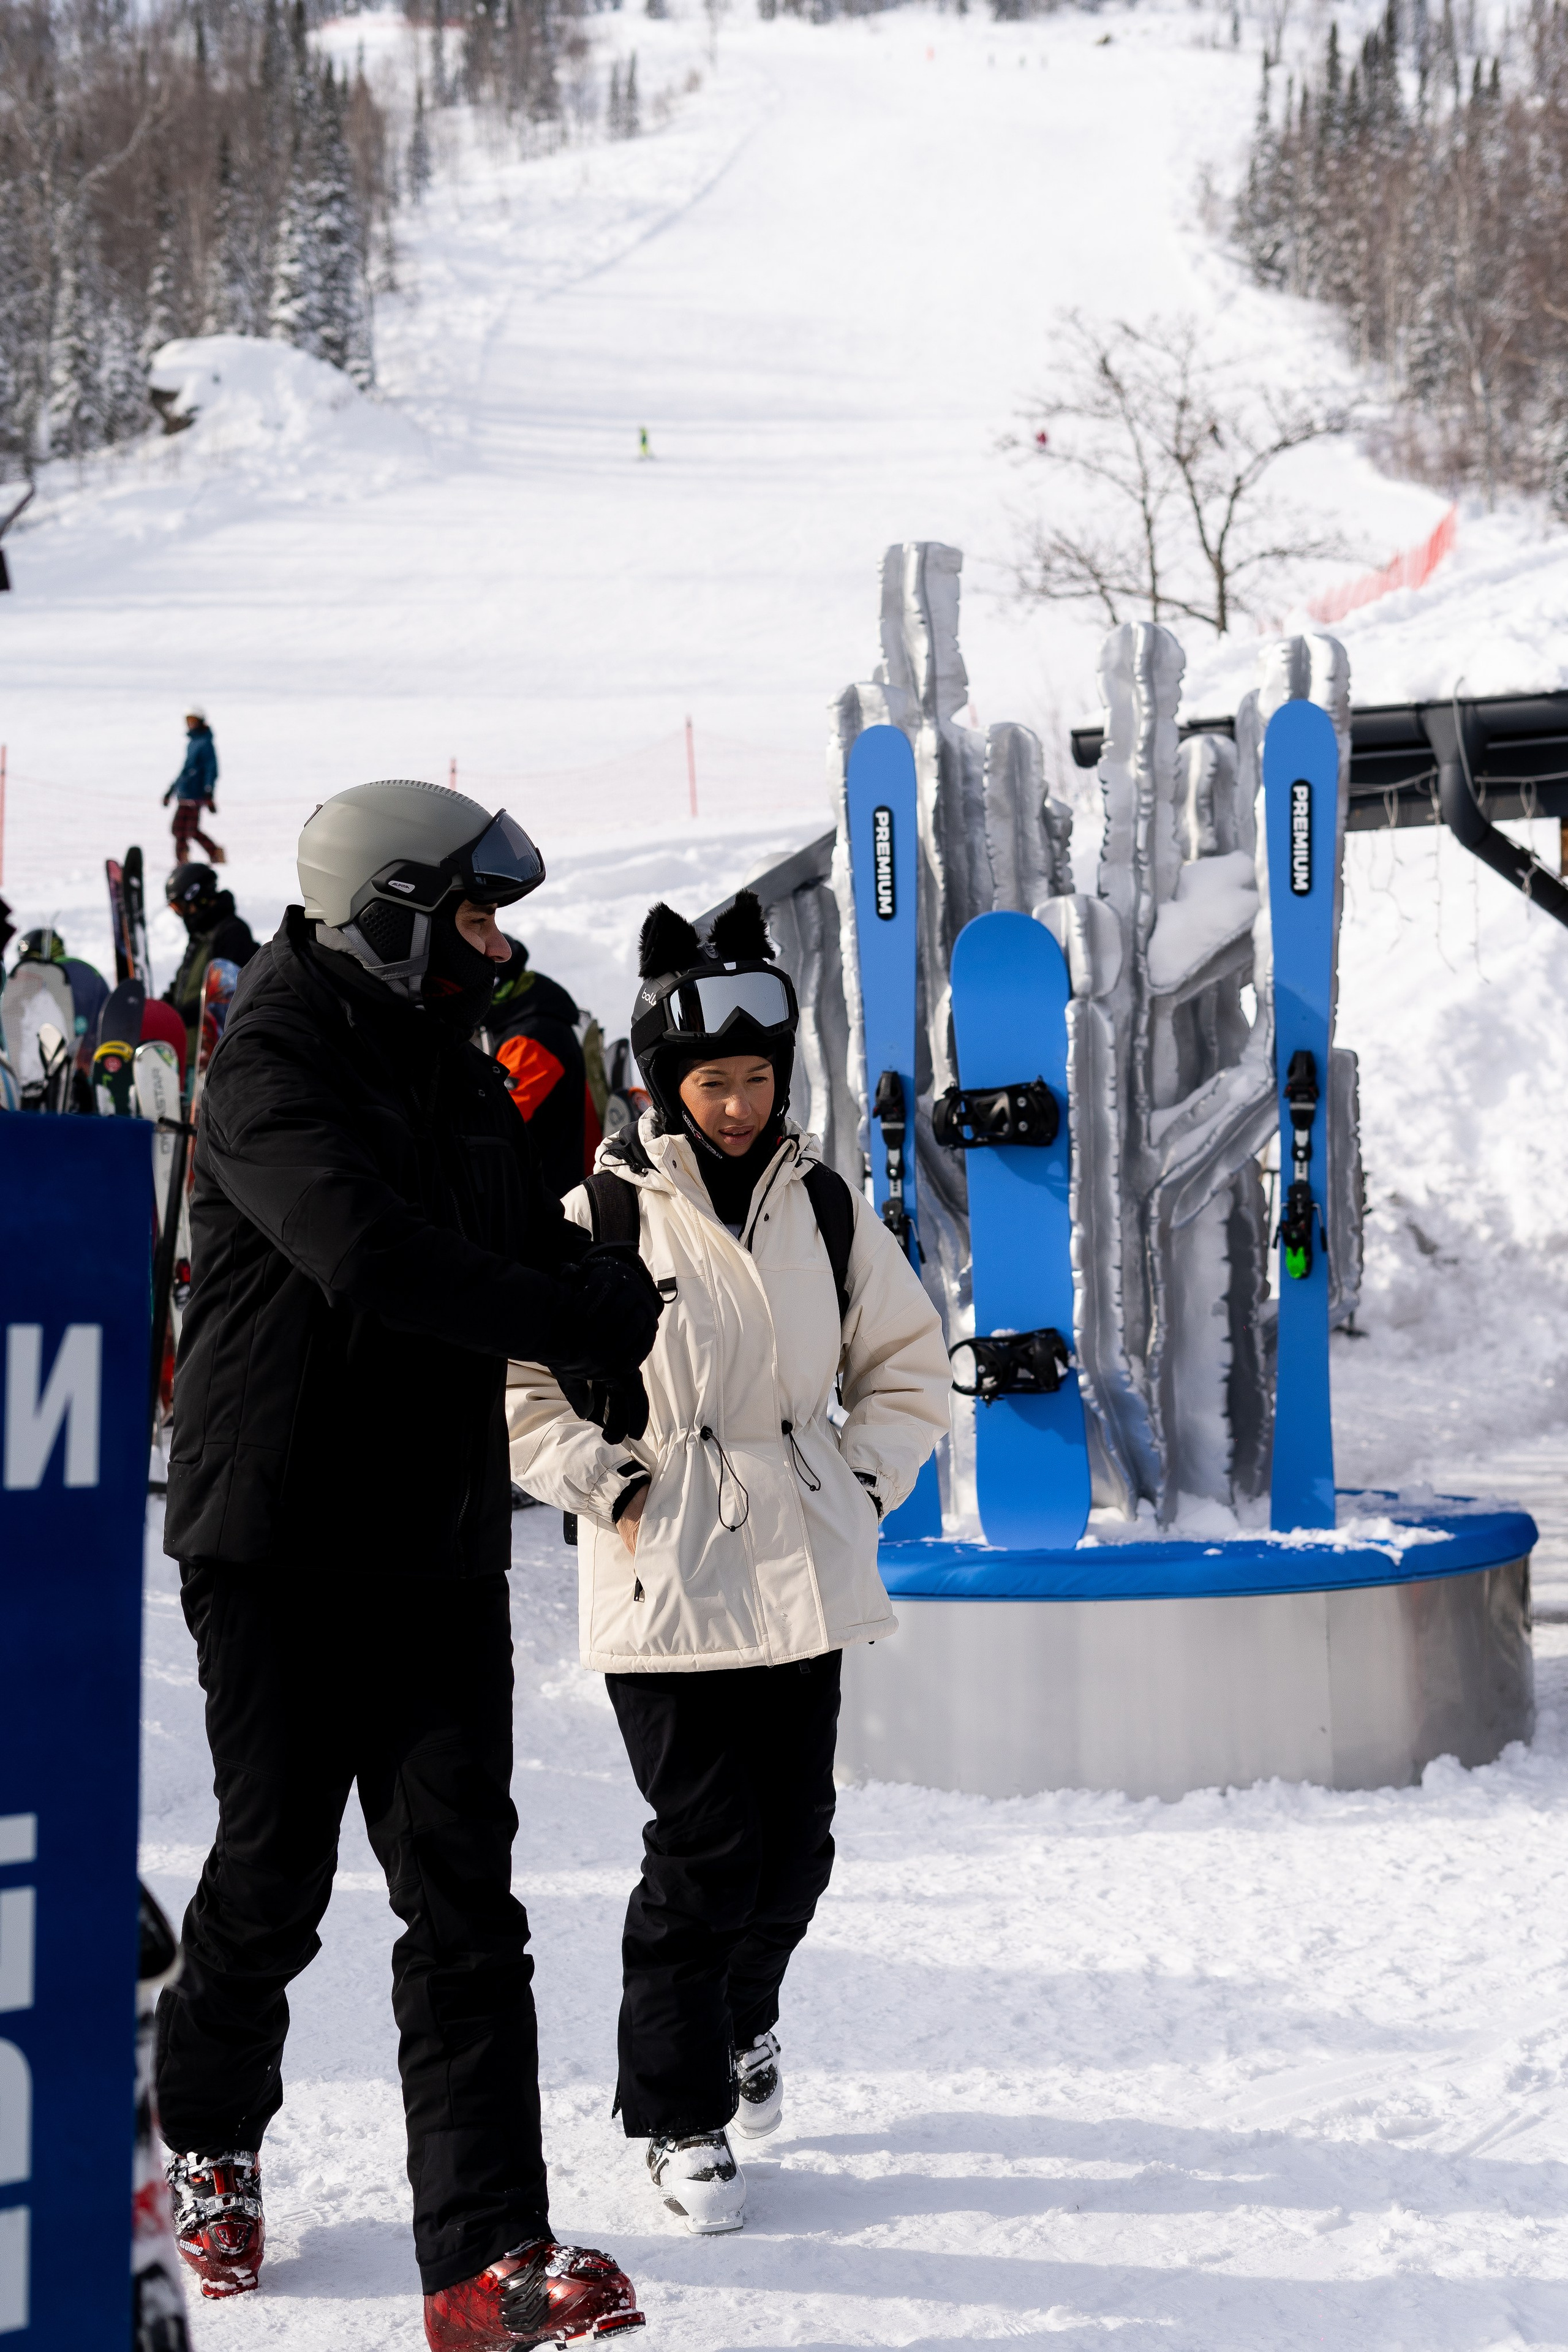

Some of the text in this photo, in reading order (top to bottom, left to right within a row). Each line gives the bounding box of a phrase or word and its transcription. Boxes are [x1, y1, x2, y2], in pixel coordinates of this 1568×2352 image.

[875, 811, 893, 914] PREMIUM
[1292, 785, 1310, 891] PREMIUM
[179, 2239, 204, 2256] ATOMIC
